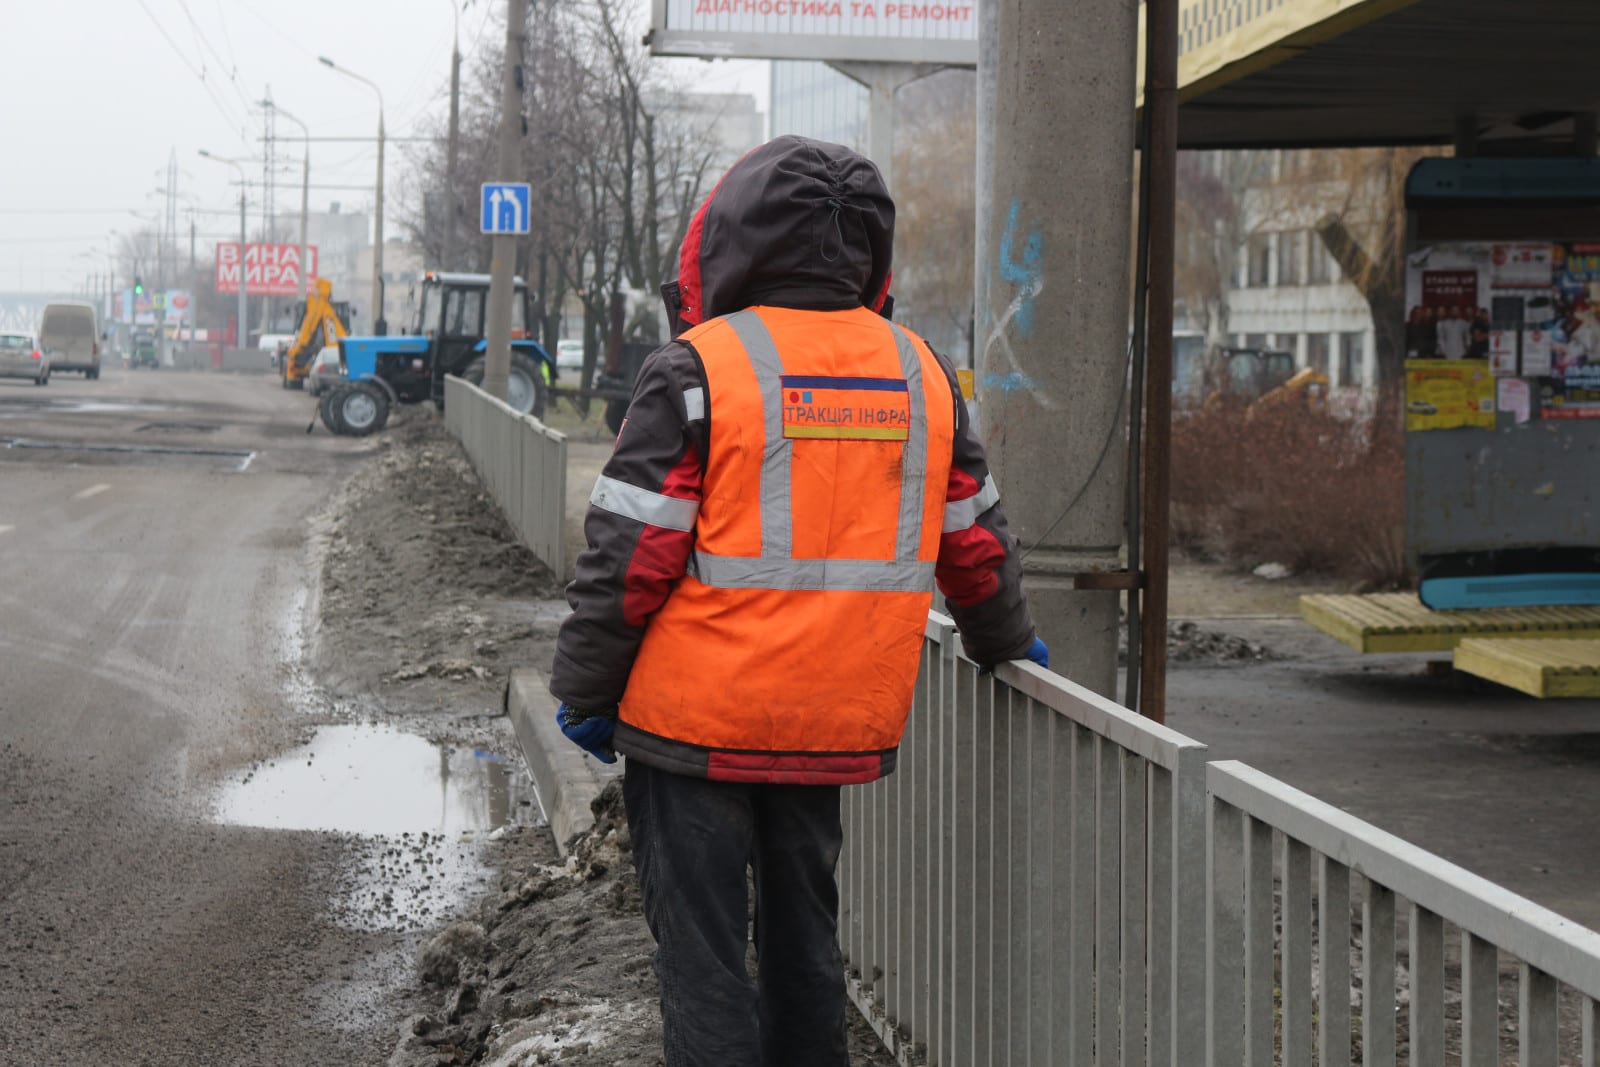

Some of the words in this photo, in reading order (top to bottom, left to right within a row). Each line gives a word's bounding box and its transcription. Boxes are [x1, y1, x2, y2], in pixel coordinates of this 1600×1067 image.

[695, 0, 842, 16] ДІАГНОСТИКА
[851, 2, 877, 17] ТА
[884, 4, 974, 21] РЕМОНТ
[220, 245, 301, 263] ВИНА
[219, 265, 300, 284] МИРА
[785, 406, 853, 423] ТРАКЦІЯ
[858, 407, 908, 425] ІНФРА
